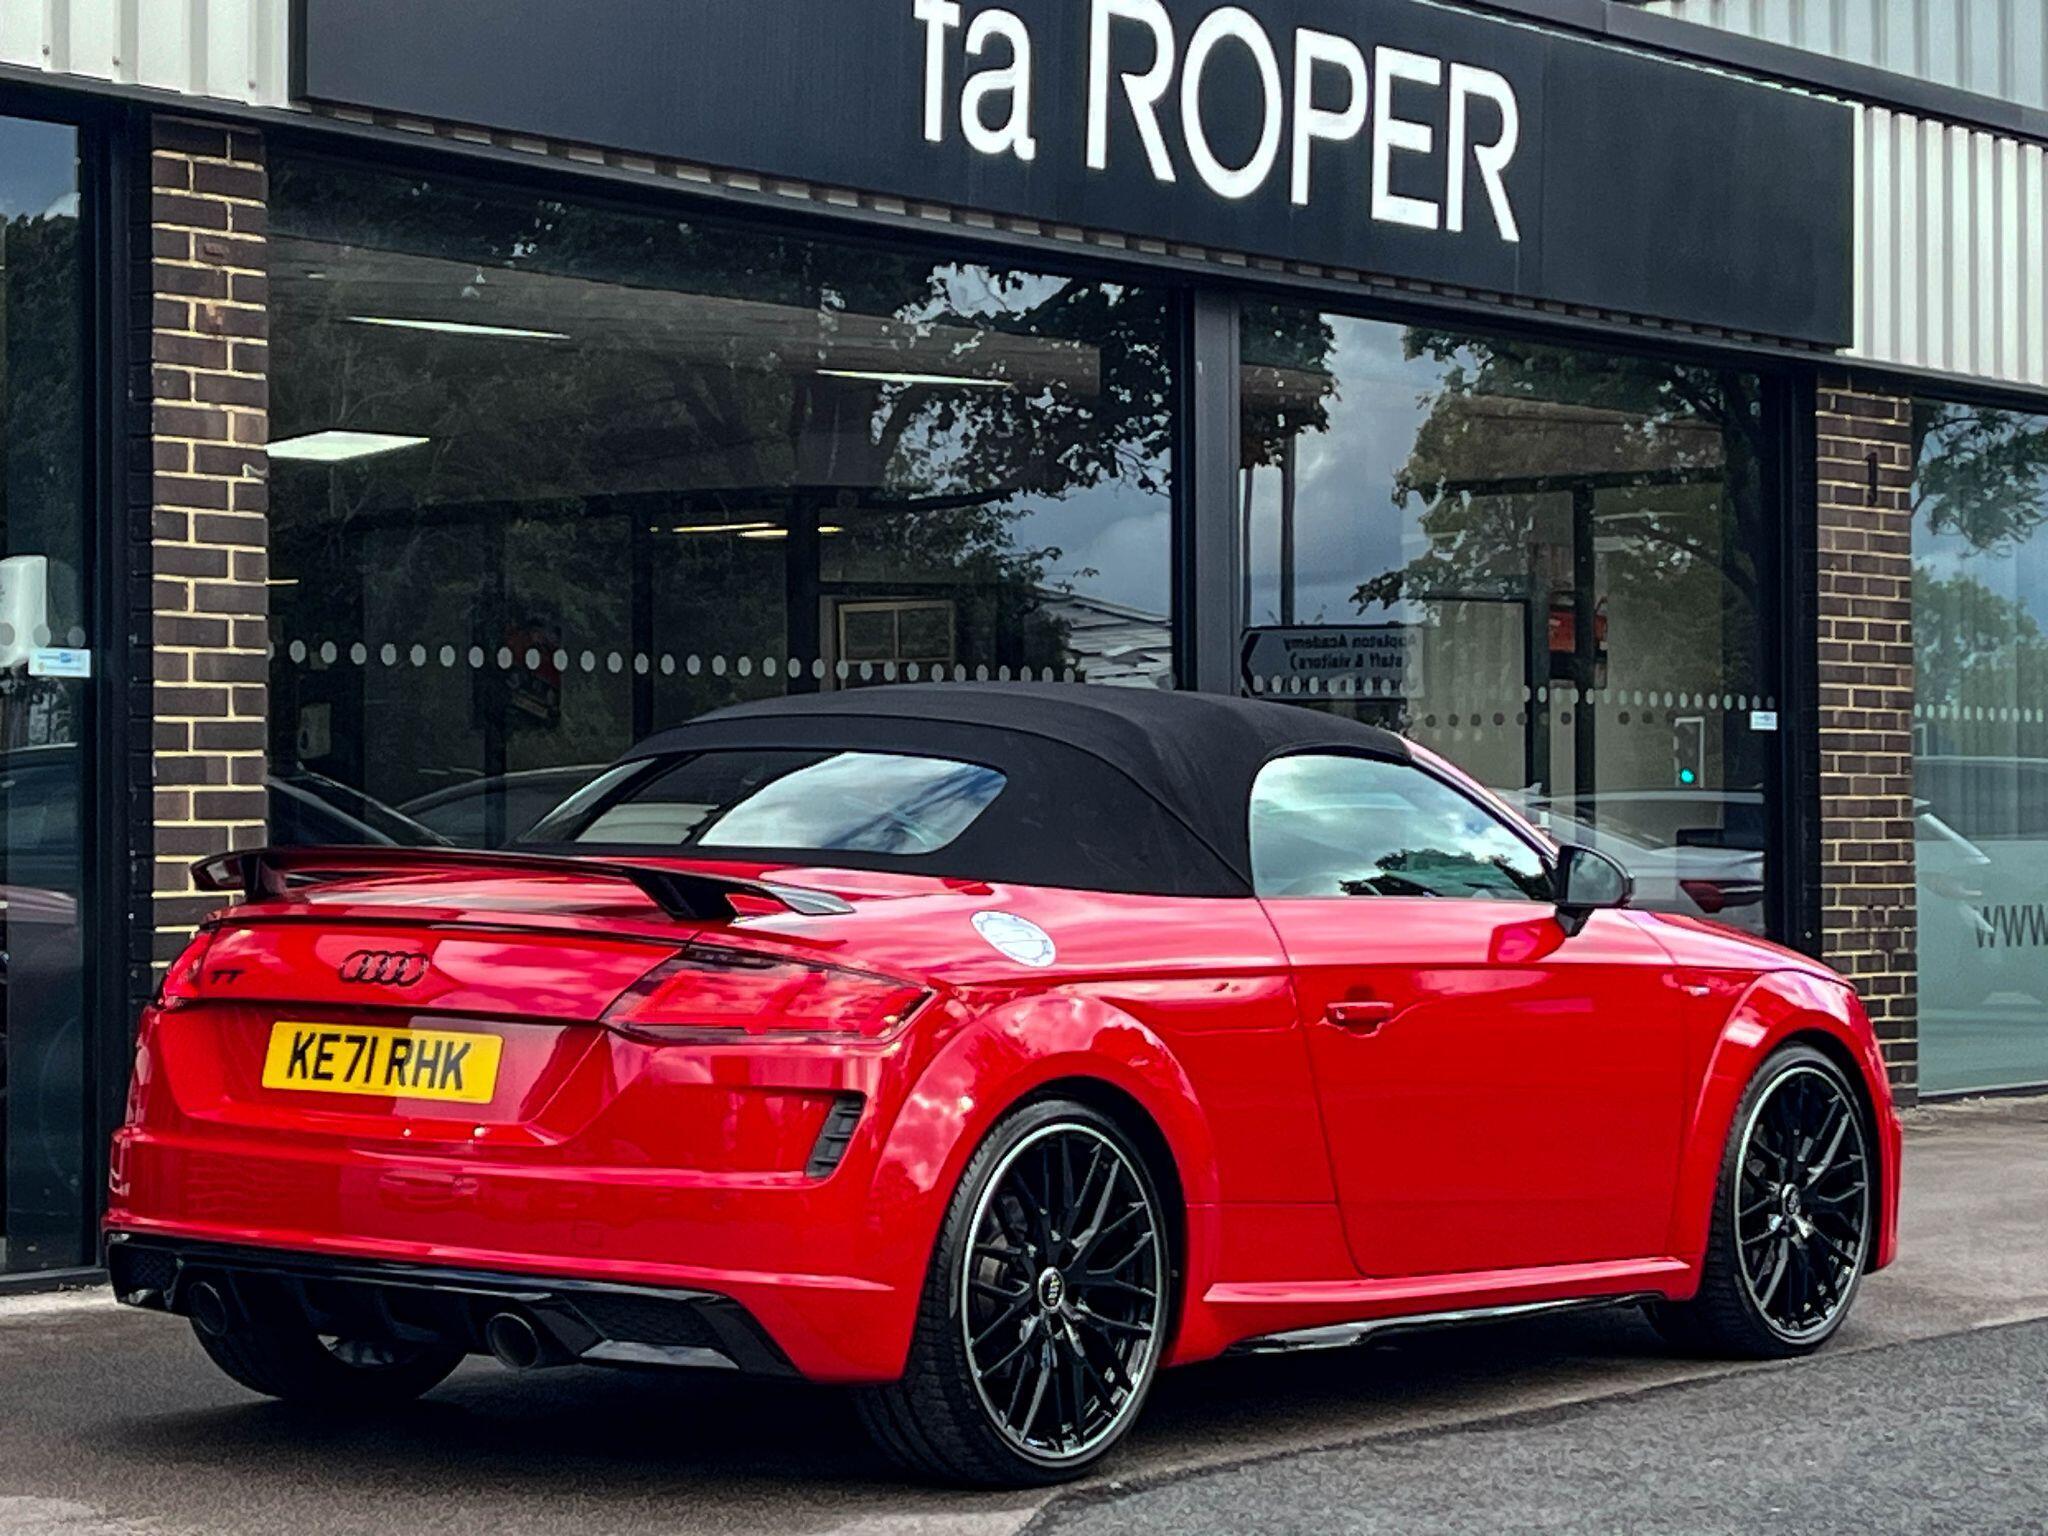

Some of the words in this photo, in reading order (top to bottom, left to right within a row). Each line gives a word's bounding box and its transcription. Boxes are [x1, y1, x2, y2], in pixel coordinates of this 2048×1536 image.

[1086, 0, 1520, 242] ROPER
[211, 969, 244, 985] TT
[287, 1031, 379, 1084] KE71
[384, 1037, 471, 1090] RHK
